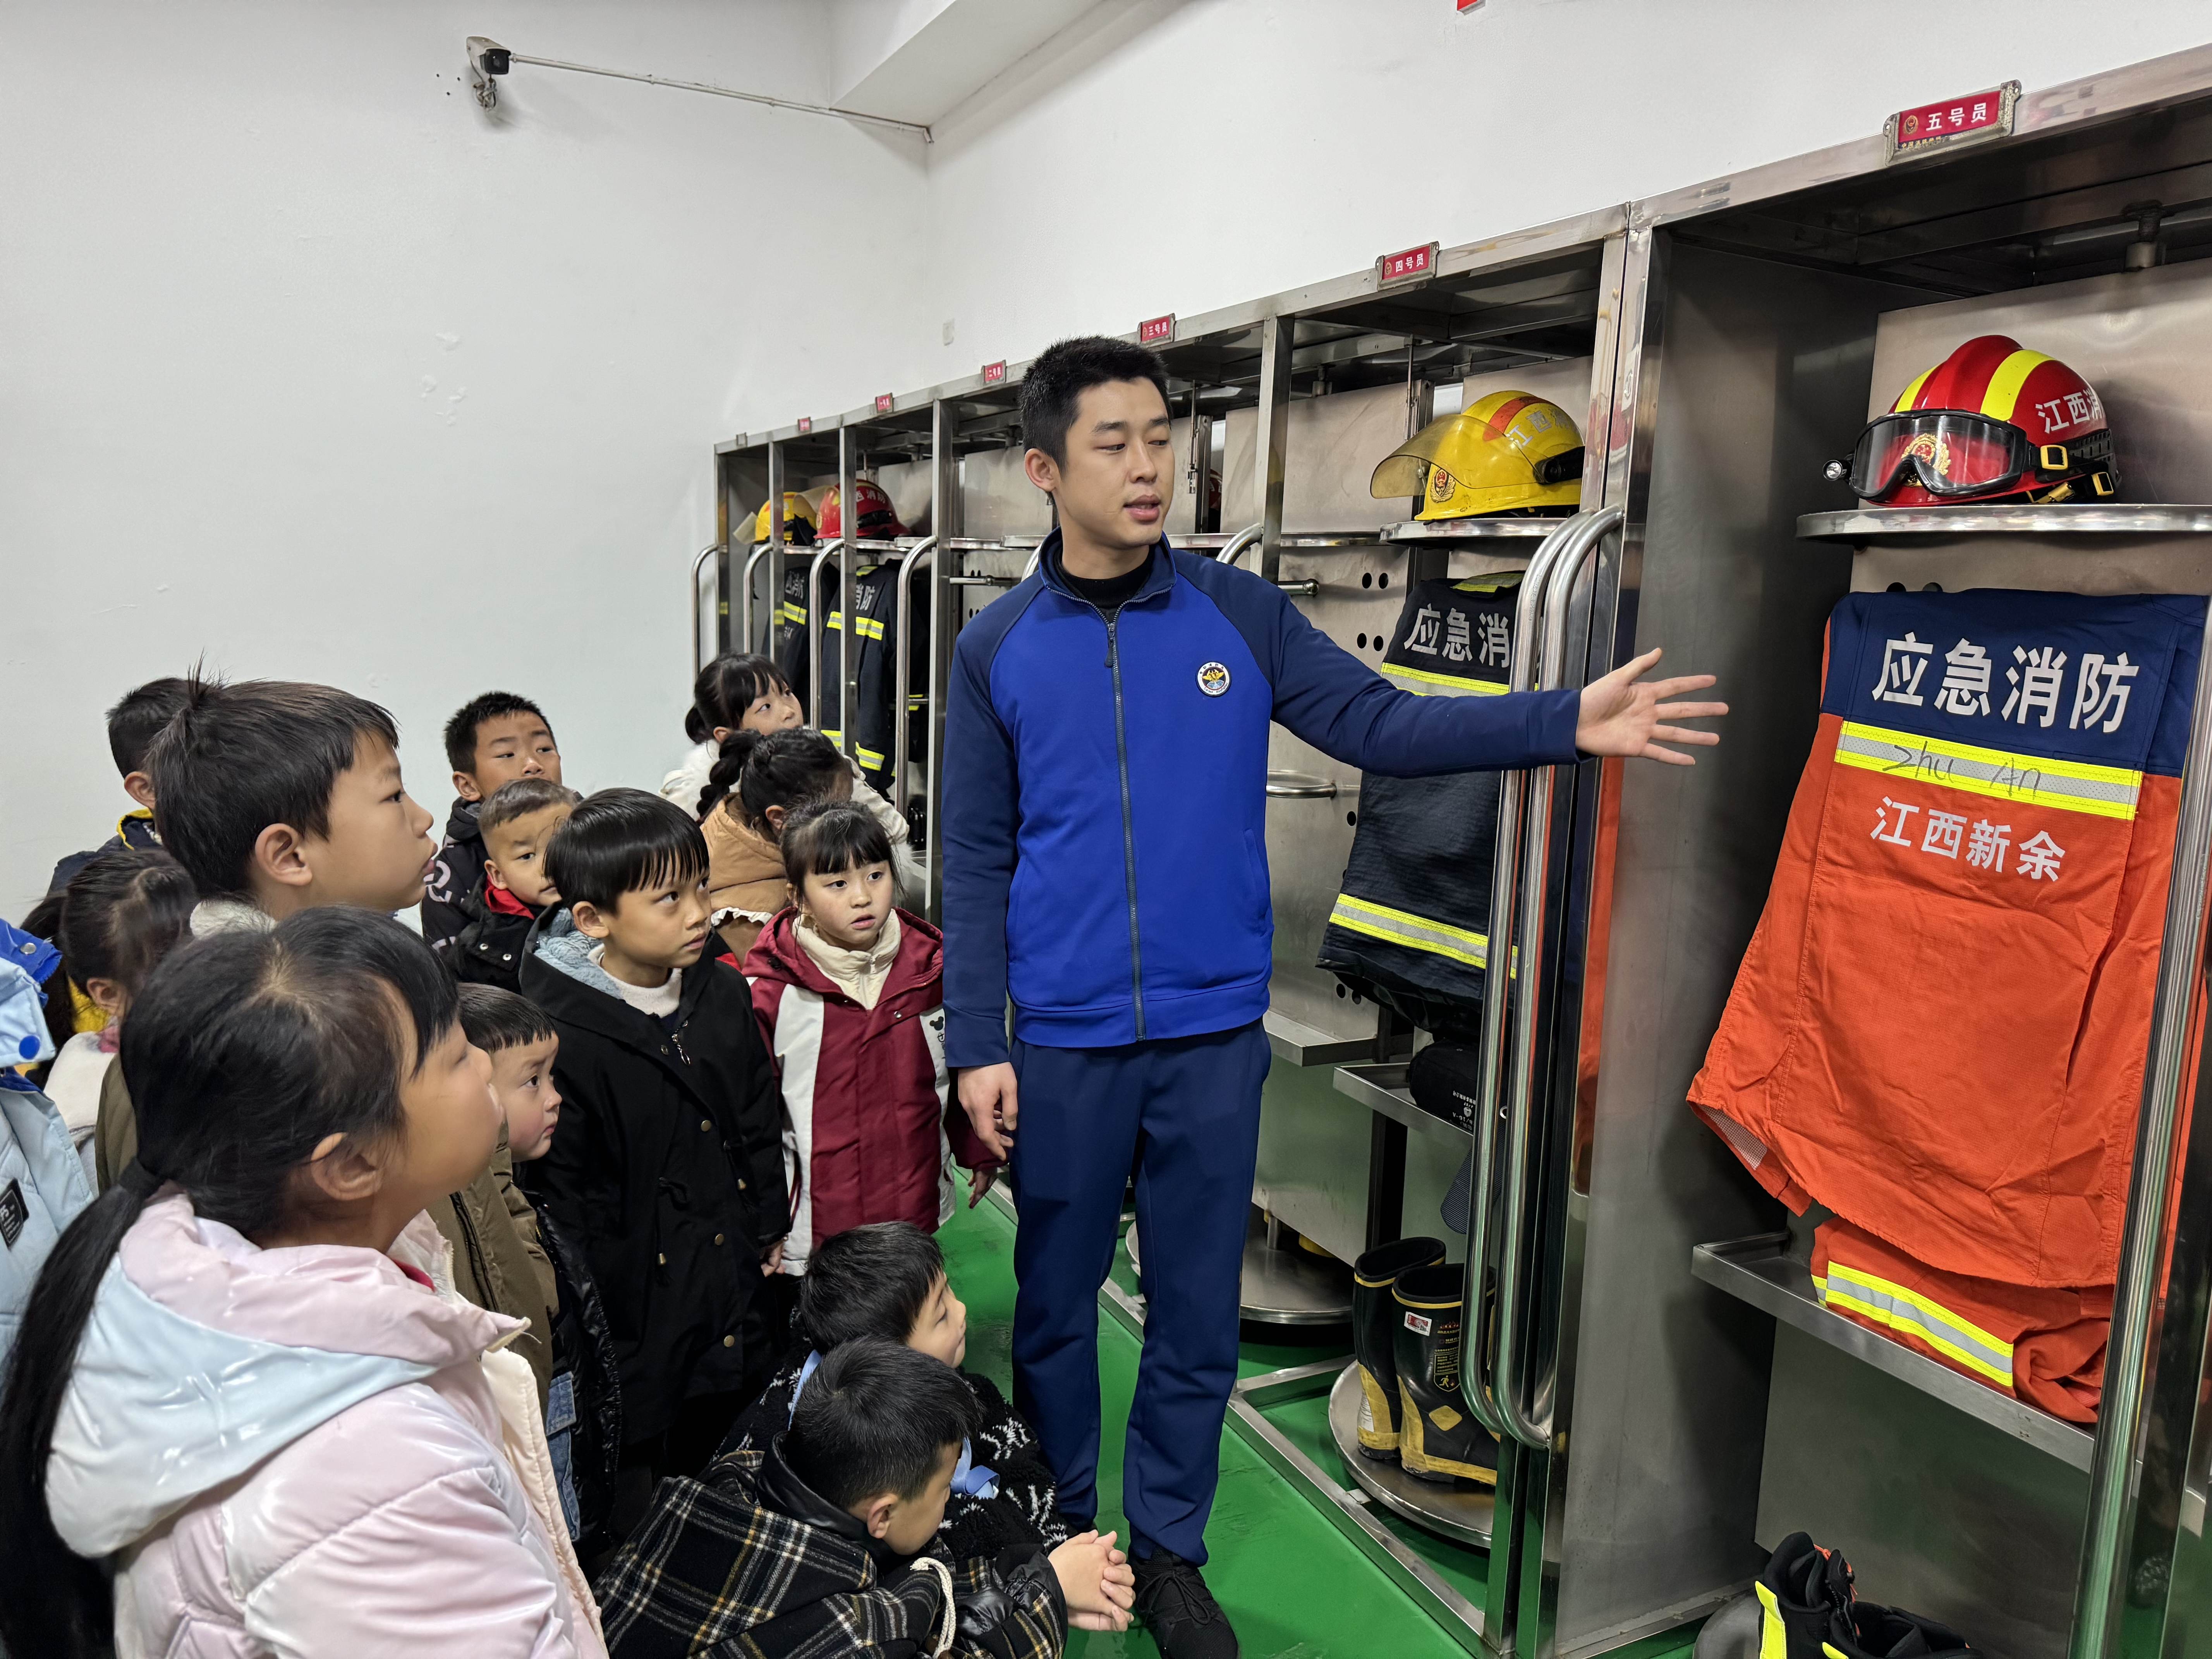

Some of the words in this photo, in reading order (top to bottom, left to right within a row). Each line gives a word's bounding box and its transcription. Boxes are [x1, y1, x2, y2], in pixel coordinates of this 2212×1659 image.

[1926, 102, 1987, 131] 五号员
[1396, 253, 1424, 273] 四号员
[1149, 322, 1167, 336] 三号员
[1404, 603, 1510, 668] 应急消
[1872, 632, 2139, 733] 应急消防
[1870, 796, 2066, 882] 江西新余
